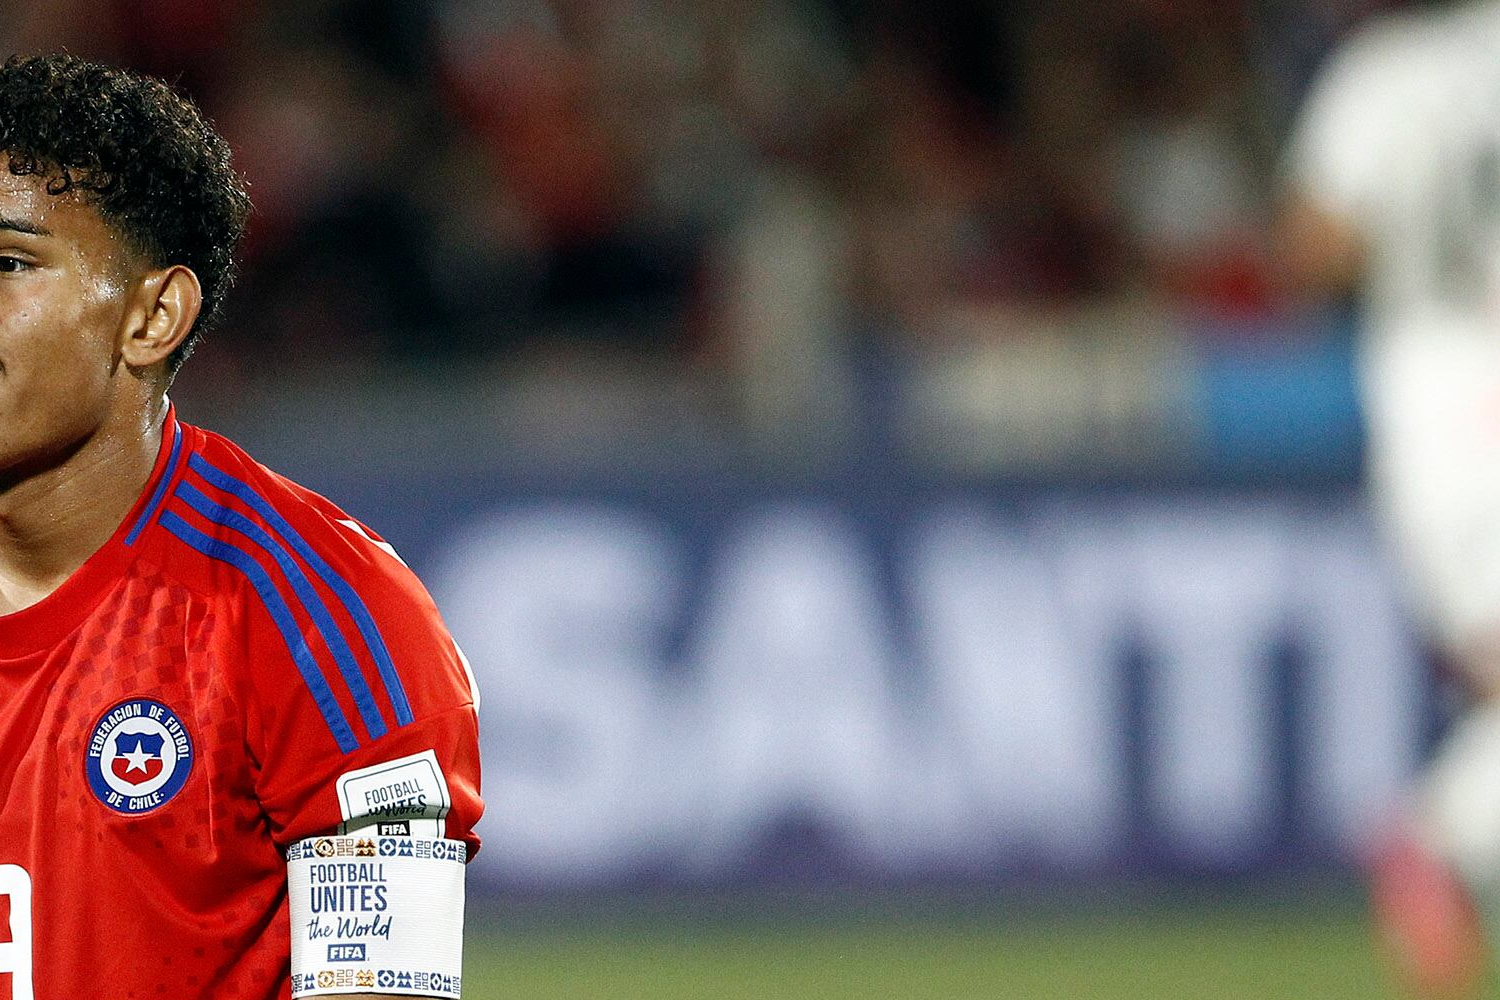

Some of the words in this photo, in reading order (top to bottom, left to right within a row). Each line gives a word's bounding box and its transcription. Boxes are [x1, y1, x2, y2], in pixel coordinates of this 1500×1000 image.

[90, 703, 141, 758] FEDERACION
[149, 704, 164, 720] DE
[164, 716, 190, 760] FUTBOL
[107, 792, 124, 808] DE
[128, 791, 162, 810] CHILE
[364, 778, 424, 806] FOOTBALL
[381, 824, 408, 836] FIFA
[310, 863, 388, 884] FOOTBALL
[310, 885, 388, 913] UNITES
[307, 916, 334, 940] the
[337, 914, 393, 941] World
[329, 946, 364, 960] FIFA
